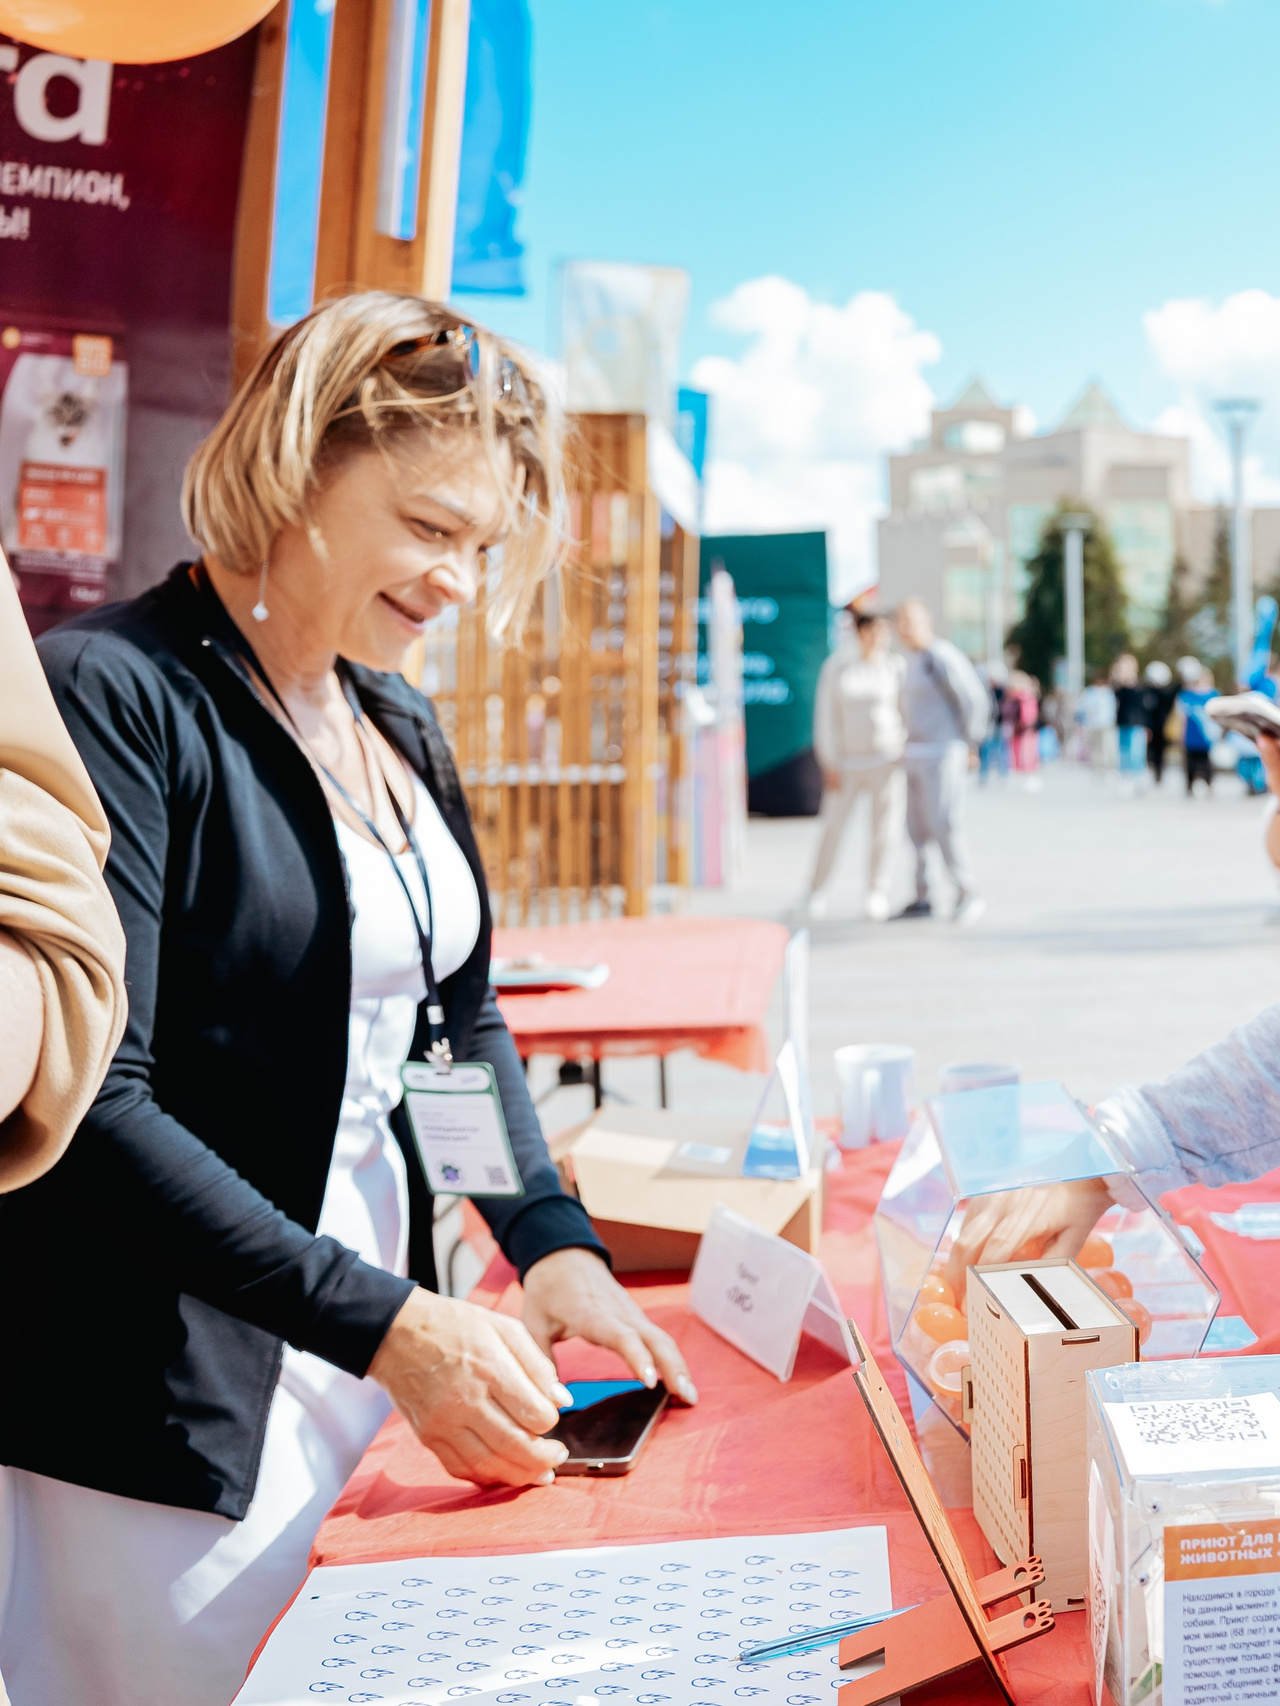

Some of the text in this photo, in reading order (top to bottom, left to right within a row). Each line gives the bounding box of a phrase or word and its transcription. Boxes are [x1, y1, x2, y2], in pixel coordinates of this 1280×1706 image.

[0, 161, 131, 212] ЕМПИОН,
[1180, 1535, 1237, 1551] ПРИЮТ
[1241, 1533, 1275, 1548] ДЛЯ
[1180, 1547, 1273, 1565] ЖИВОТНЫХ
